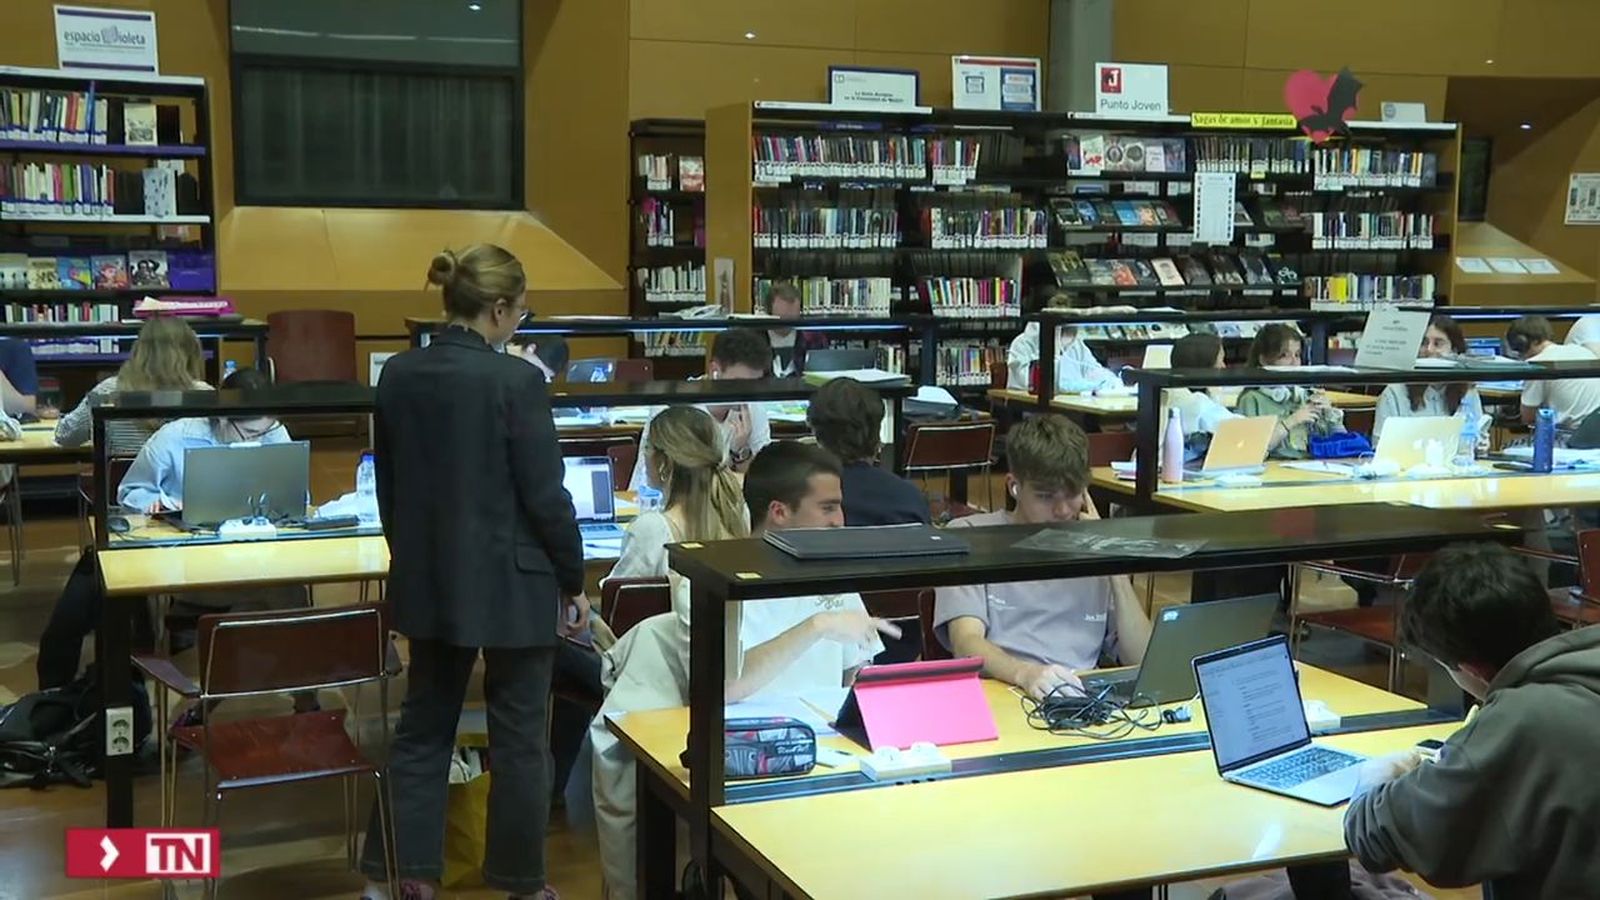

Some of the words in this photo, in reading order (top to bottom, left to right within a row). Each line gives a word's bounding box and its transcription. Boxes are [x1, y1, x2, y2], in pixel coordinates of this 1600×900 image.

[64, 30, 100, 43] espacio
[1108, 69, 1119, 87] J
[1100, 99, 1129, 110] Punto
[1131, 100, 1162, 111] Joven
